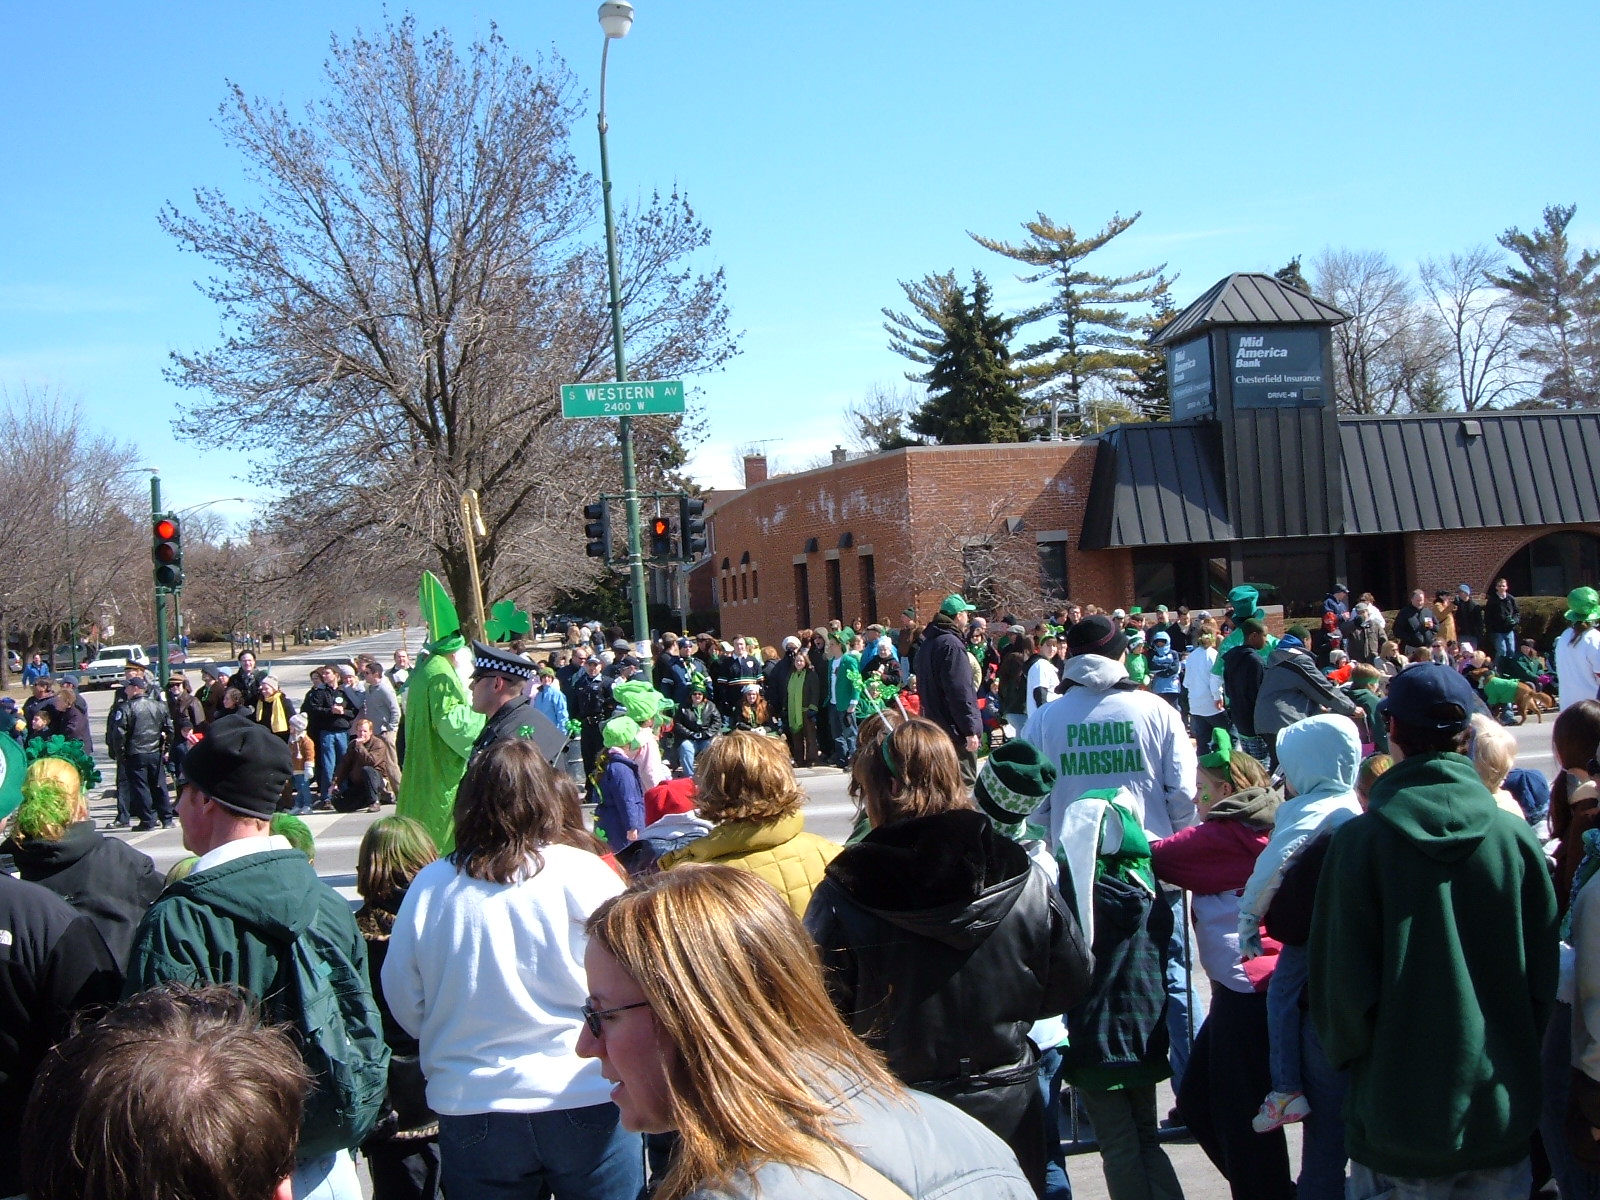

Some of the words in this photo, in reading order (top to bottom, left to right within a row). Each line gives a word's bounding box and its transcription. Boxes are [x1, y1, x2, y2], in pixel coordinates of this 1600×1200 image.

[1240, 336, 1263, 347] Mid
[1236, 347, 1288, 358] America
[1235, 358, 1261, 368] Bank
[1235, 374, 1282, 384] Chesterfield
[1284, 374, 1321, 383] Insurance
[569, 391, 575, 400] S
[585, 386, 654, 401] WESTERN
[664, 387, 677, 397] AV
[604, 402, 631, 412] 2400
[637, 401, 645, 410] W
[1067, 721, 1134, 747] PARADE
[1060, 748, 1145, 776] MARSHAL
